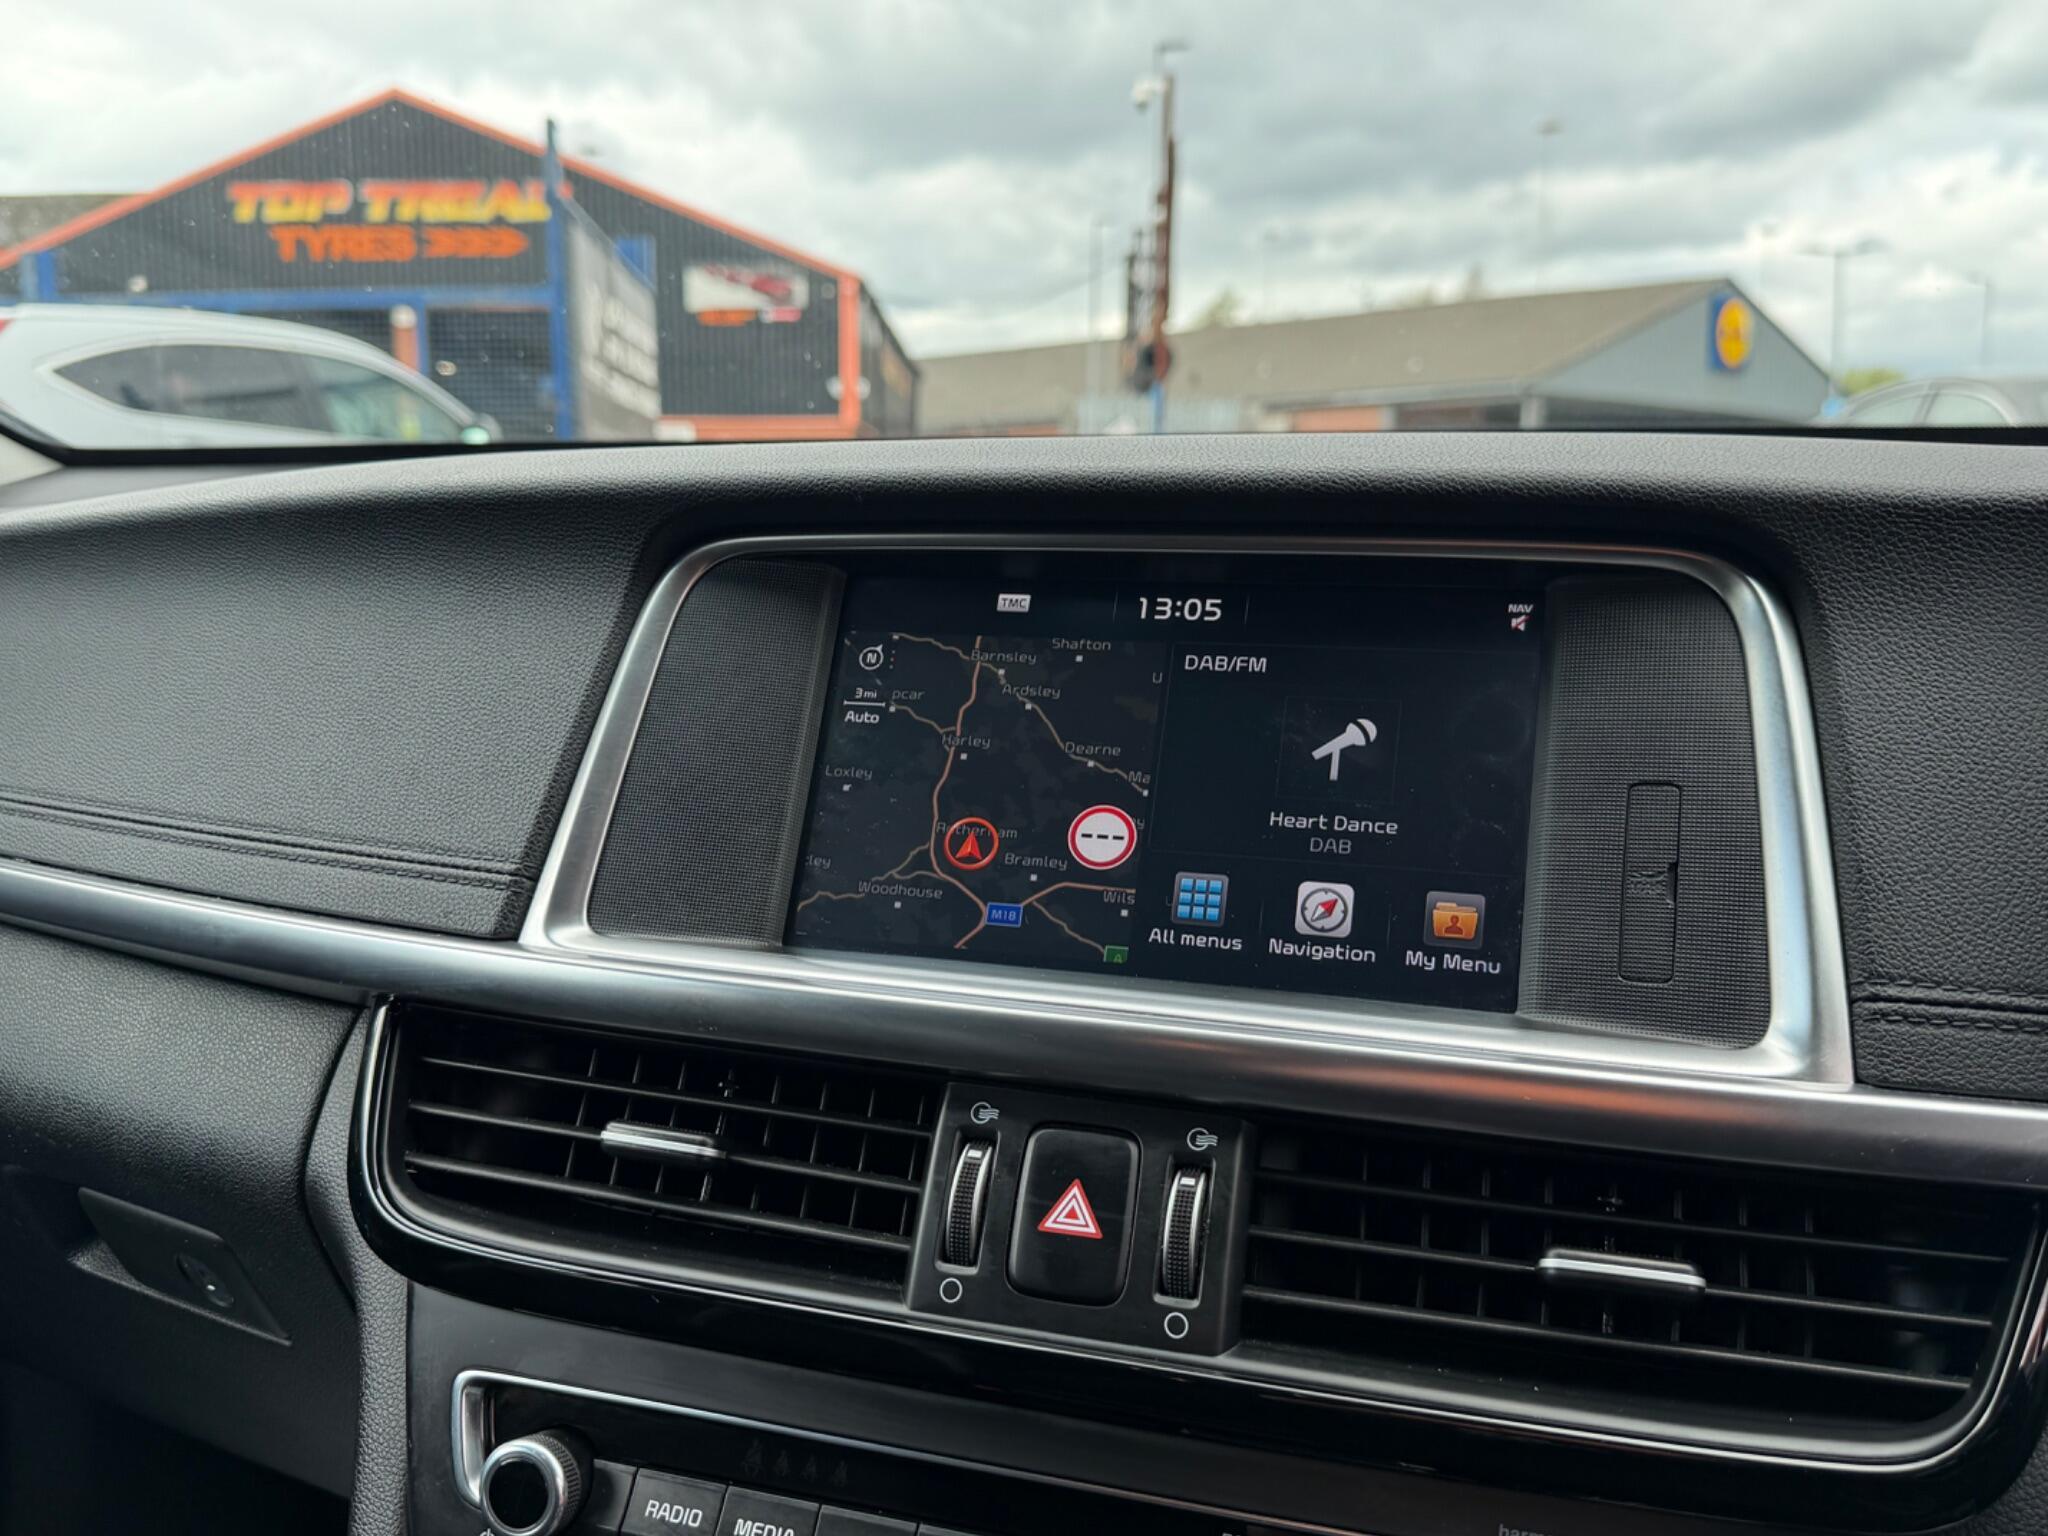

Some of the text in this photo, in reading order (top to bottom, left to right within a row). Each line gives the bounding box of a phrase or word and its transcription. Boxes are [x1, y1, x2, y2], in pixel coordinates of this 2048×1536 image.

[227, 179, 353, 224] TOP
[1000, 597, 1028, 609] TMC
[1138, 596, 1222, 621] 13:05
[1508, 603, 1533, 613] NAV
[1051, 637, 1111, 651] Shafton
[970, 649, 1037, 665] Barnsley
[1184, 654, 1267, 673] DAB/FM
[1002, 682, 1061, 699] Ardsley
[844, 710, 880, 724] Auto
[941, 734, 991, 749] Harley
[1065, 741, 1121, 756] Dearne
[825, 765, 873, 781] Loxley
[1269, 811, 1398, 835] Heart Dance
[1309, 836, 1352, 854] DAB
[1004, 853, 1068, 871] Bramley
[858, 880, 943, 900] Woodhouse
[1103, 890, 1136, 905] Wils
[991, 908, 1016, 922] M18
[1148, 928, 1242, 951] All menus
[1268, 938, 1376, 964] Navigation
[1405, 950, 1502, 975] My Menu
[644, 1499, 703, 1527] RADIO
